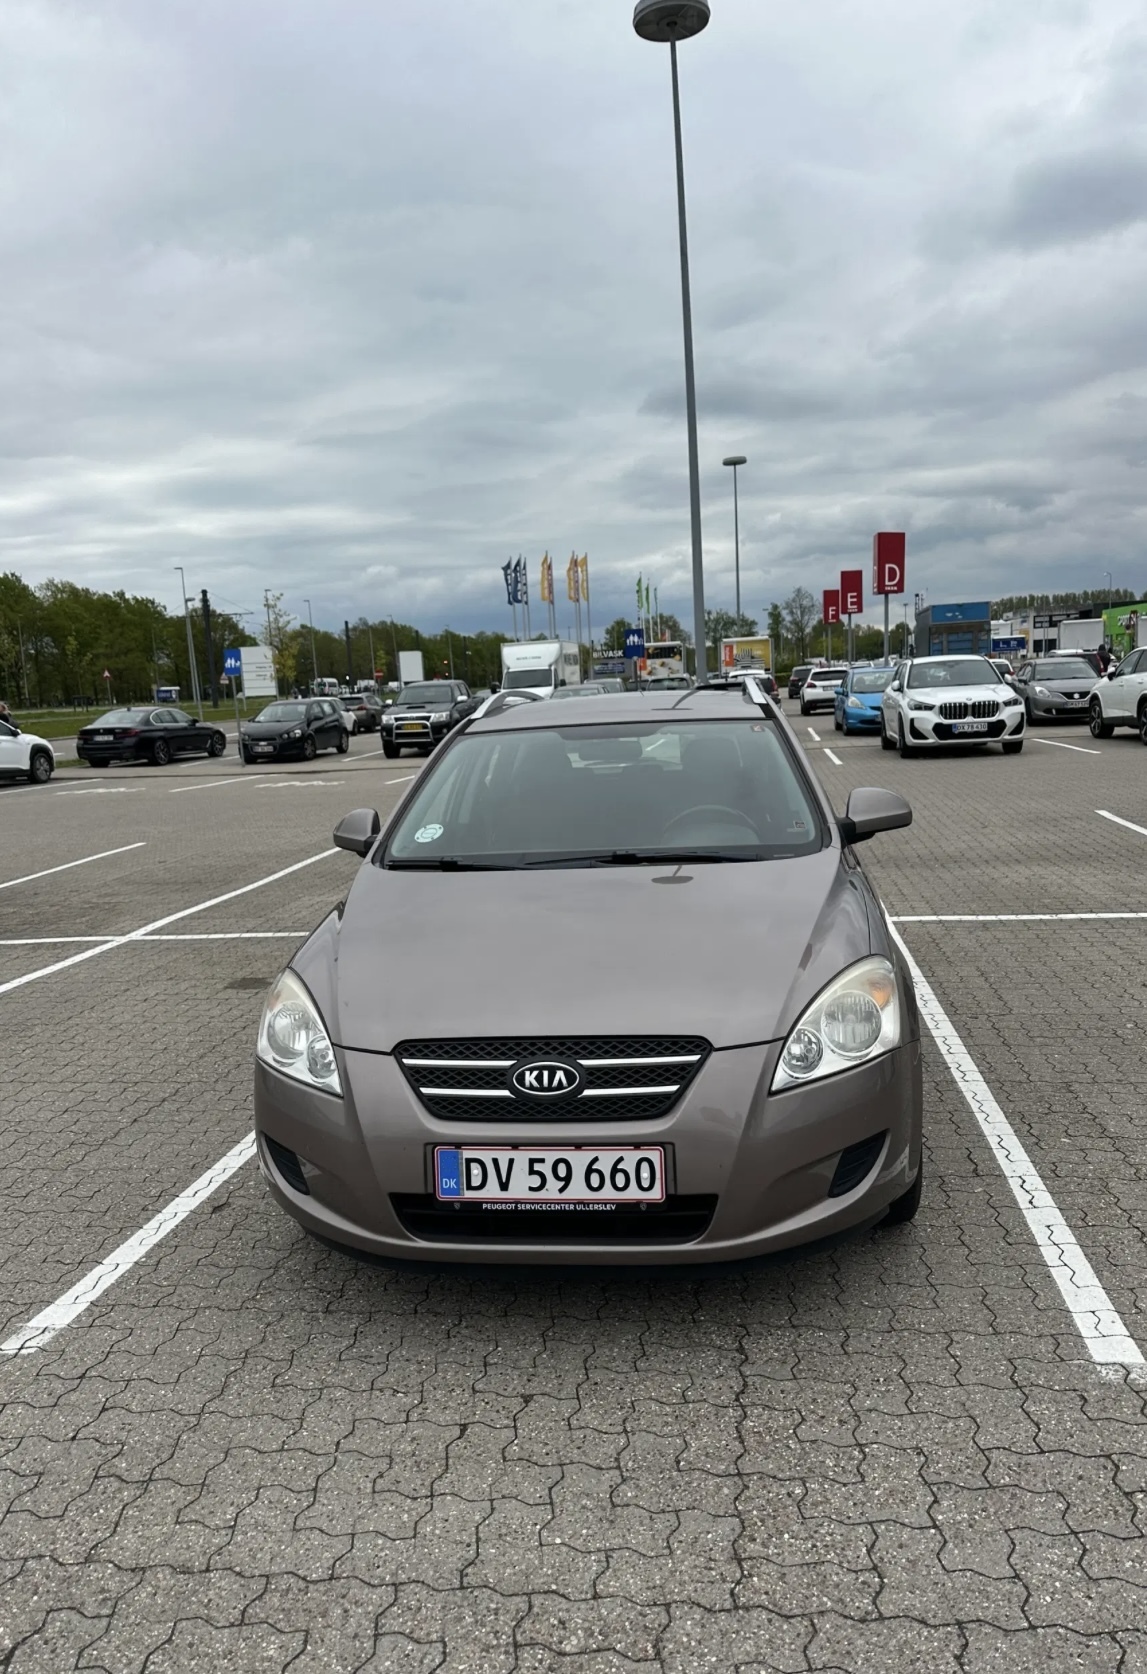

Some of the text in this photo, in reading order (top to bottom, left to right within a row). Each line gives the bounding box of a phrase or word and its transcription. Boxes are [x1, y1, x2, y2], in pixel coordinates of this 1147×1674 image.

[885, 563, 900, 585] D
[847, 592, 858, 608] E
[828, 606, 836, 619] F
[592, 649, 624, 659] BILVASK
[523, 1070, 569, 1088] KIA
[464, 1155, 656, 1194] DV 59 660
[442, 1178, 457, 1189] DK
[482, 1203, 616, 1211] PEUGEOT SERVICECENTER ULLERSLEV
